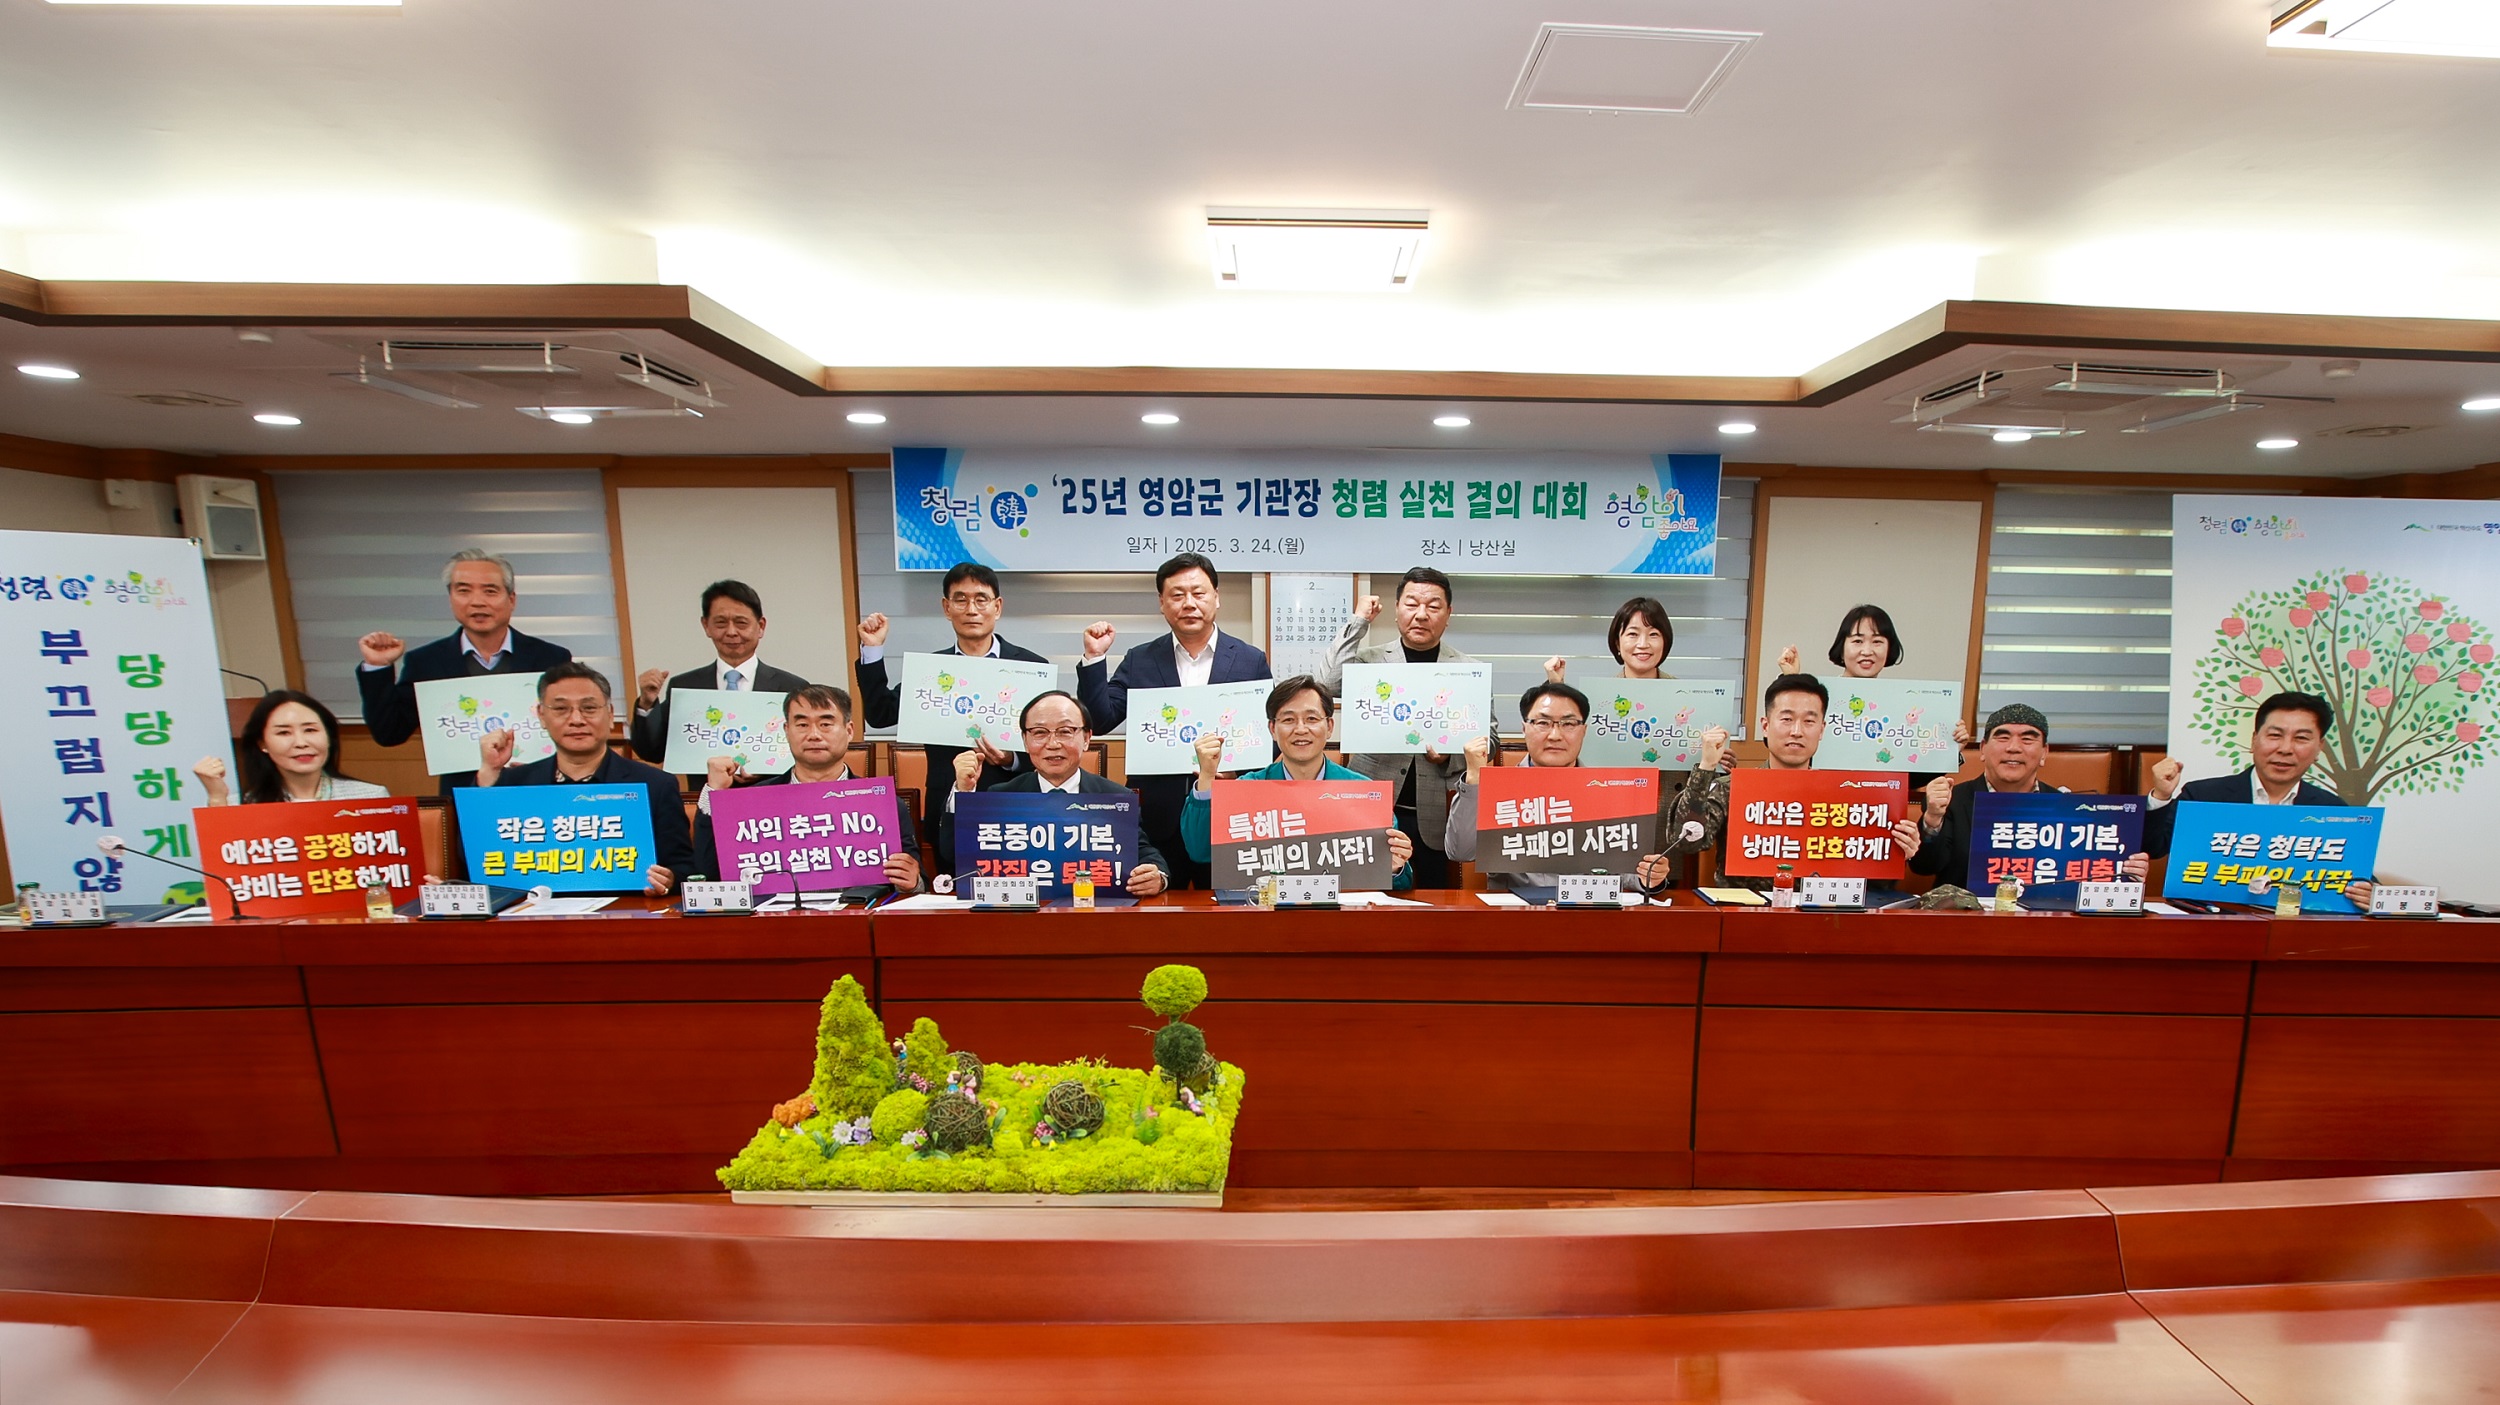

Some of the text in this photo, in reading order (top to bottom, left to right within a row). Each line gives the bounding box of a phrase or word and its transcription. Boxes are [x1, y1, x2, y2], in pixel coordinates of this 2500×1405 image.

[921, 487, 983, 532] 청렴
[1138, 477, 1225, 517] 영암군
[1235, 477, 1322, 518] 기관장
[1331, 479, 1388, 519] 청렴
[1399, 479, 1455, 519] 실천
[1466, 480, 1522, 520] 결의
[1532, 481, 1588, 520] 대회
[2199, 516, 2229, 535] 청렴
[1126, 536, 1305, 556] 일자 2025. 3. 24.(월)
[1420, 539, 1516, 557] 장소 낭산실
[1308, 582, 1315, 590] 2
[915, 688, 952, 717] 청렴
[1355, 699, 1391, 725] 청렴
[40, 629, 116, 828] 부끄럽지
[437, 716, 481, 741] 청렴
[683, 722, 720, 748] 청렴
[1141, 722, 1177, 747] 청렴
[1591, 714, 1629, 741] 청렴
[1828, 713, 1863, 741] 청렴
[117, 653, 193, 858] 당당하게
[734, 811, 884, 843] 사익 추구 No,
[1227, 809, 1307, 841] 특혜는
[1494, 796, 1574, 828] 특혜는
[1744, 801, 1893, 831] 예산은 공정하게,
[496, 814, 624, 843] 작은 청탁도
[976, 823, 1123, 855] 존중이 기본,
[1501, 822, 1639, 861] 부패의 시작!
[1990, 821, 2126, 855] 존중이 기본,
[221, 829, 407, 866] 예산은 공정하게,
[482, 846, 639, 876] 큰 부패의 시작
[737, 842, 888, 874] 공익 실천 Yes!
[1236, 835, 1376, 876] 부패의 시작!
[1742, 834, 1892, 861] 낭비는 단호하게!
[2209, 832, 2347, 862] 작은 청탁도
[225, 864, 412, 902] 낭비는 단호하게!
[1062, 859, 1123, 888] 퇴출!
[1986, 857, 2124, 885] 갑질은 퇴출!
[2182, 861, 2354, 894] 큰 부패의 시작
[1279, 891, 1336, 901] 우승희
